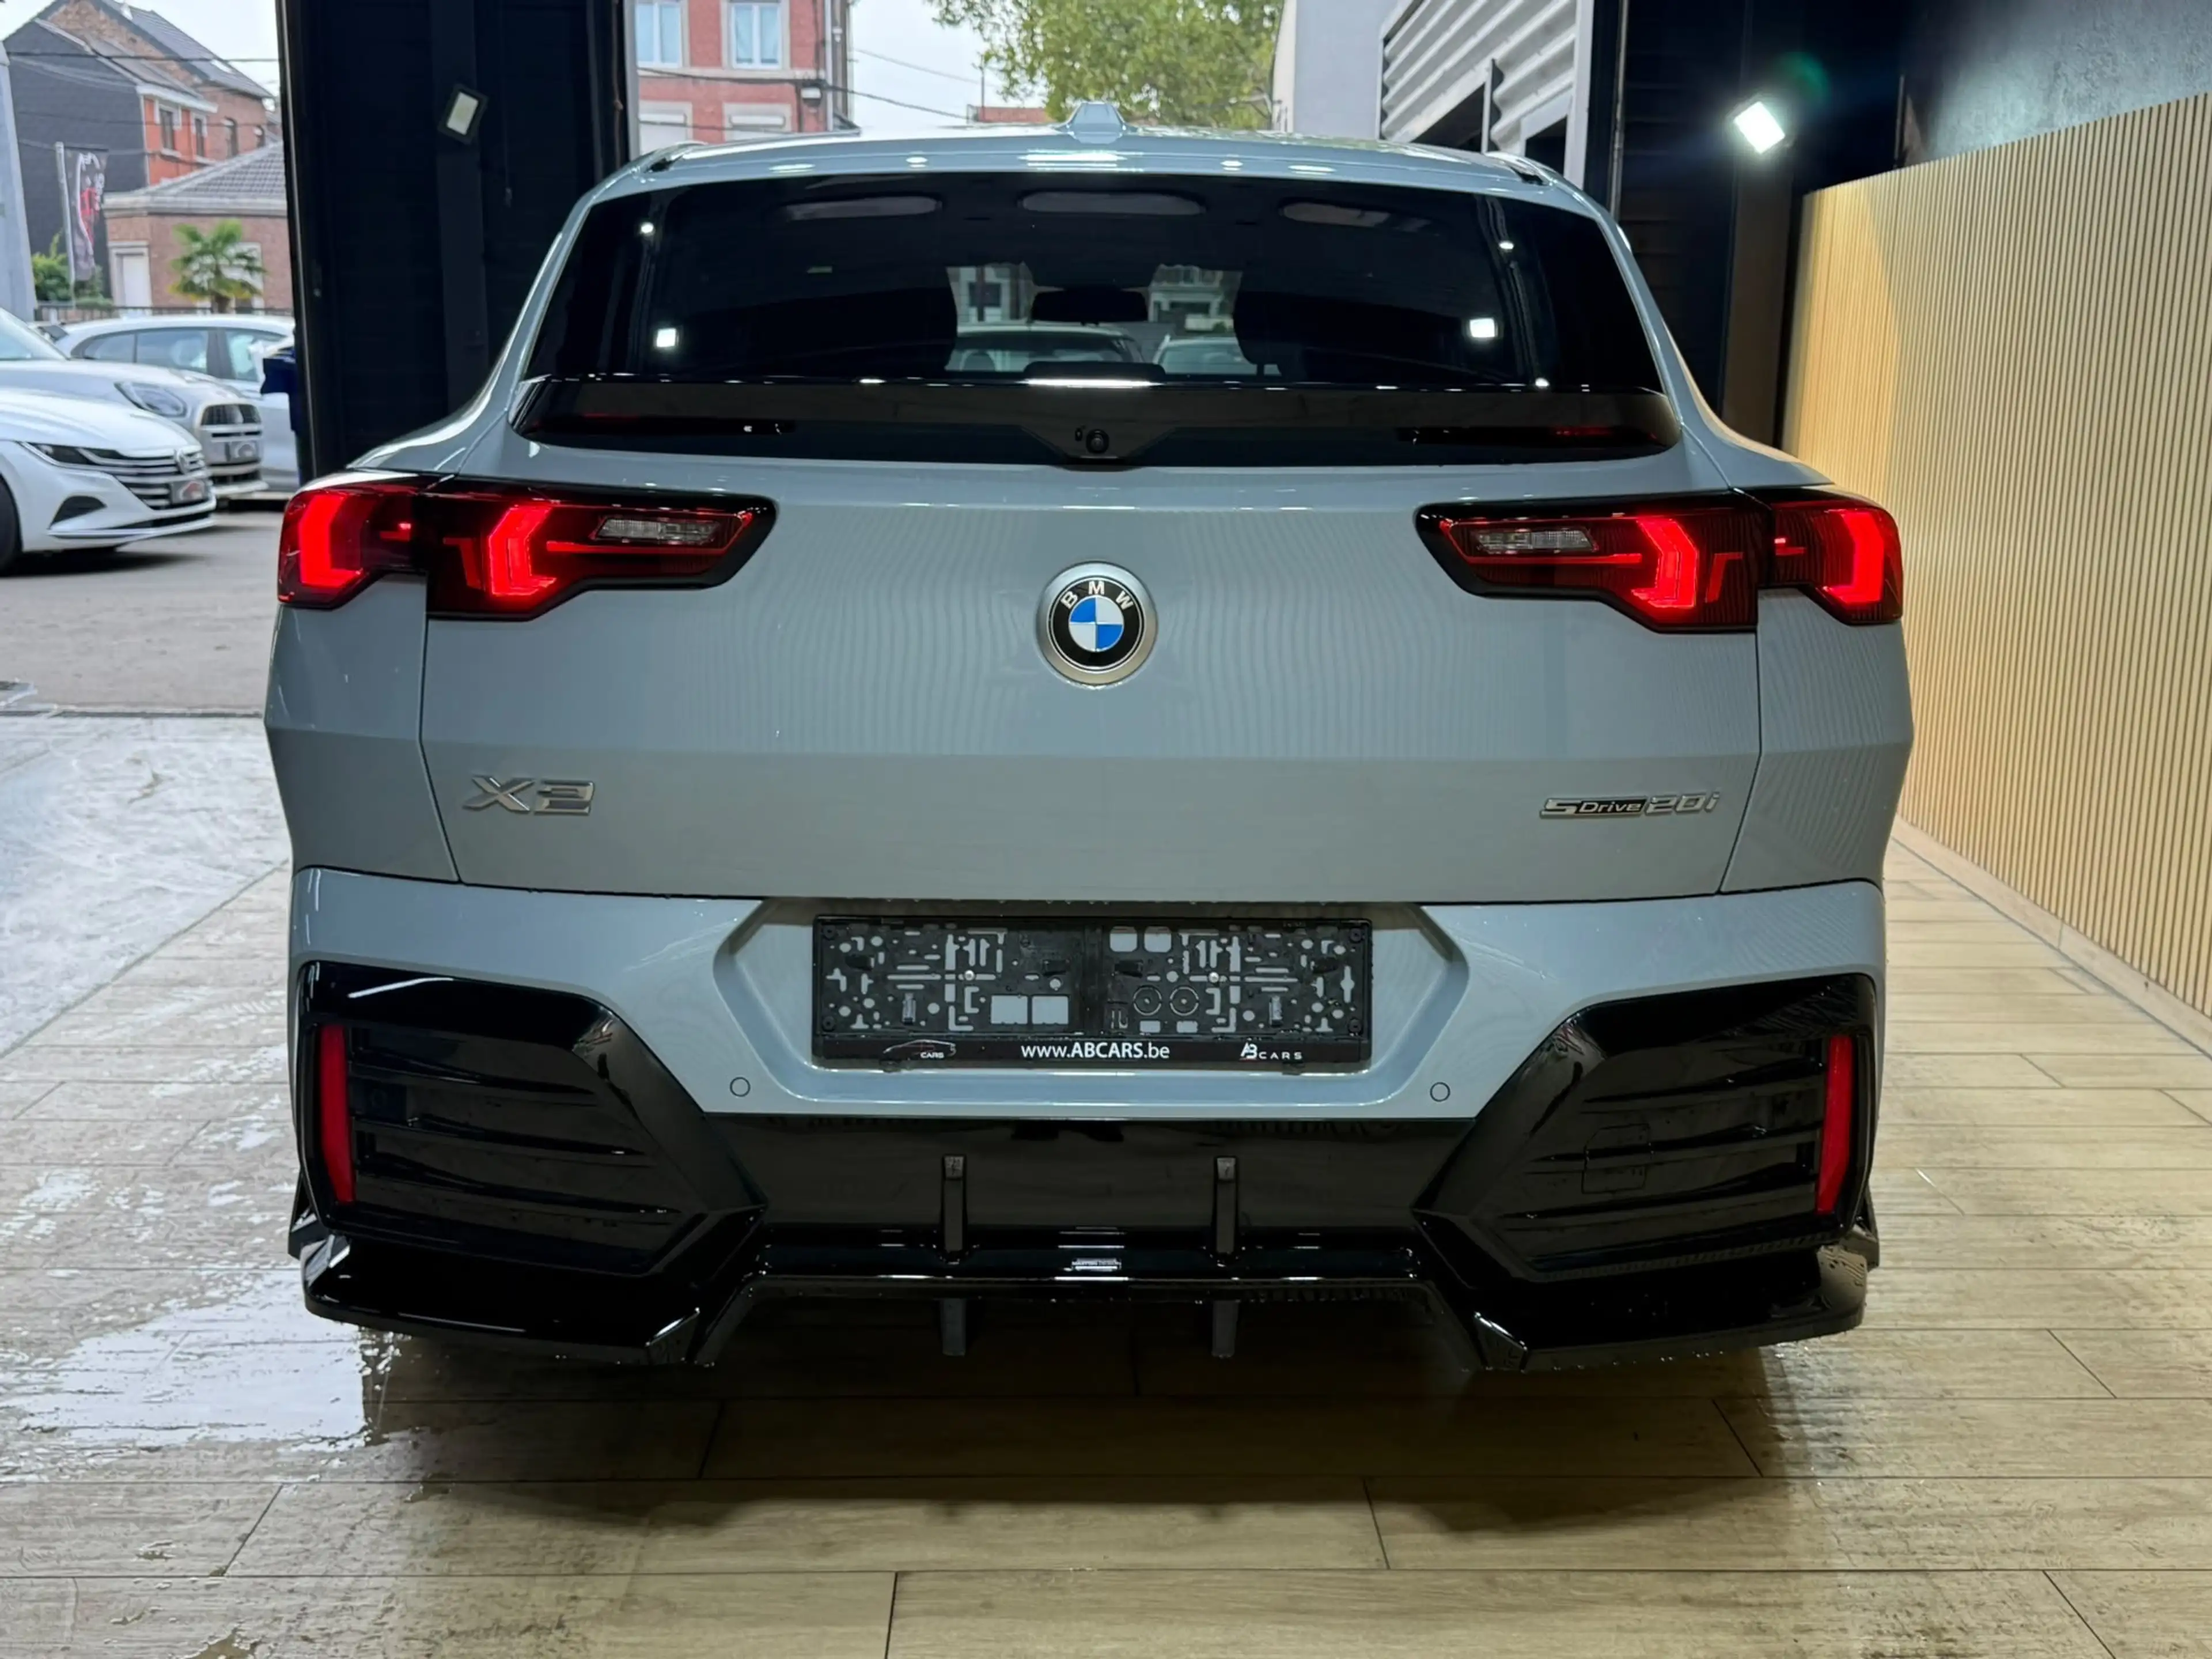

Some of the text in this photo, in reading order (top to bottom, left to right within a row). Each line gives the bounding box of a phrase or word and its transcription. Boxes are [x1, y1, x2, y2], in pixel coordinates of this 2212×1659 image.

[1060, 580, 1134, 610] BMW
[462, 774, 595, 816] X2
[1021, 1041, 1170, 1059] www.ABCARS.be
